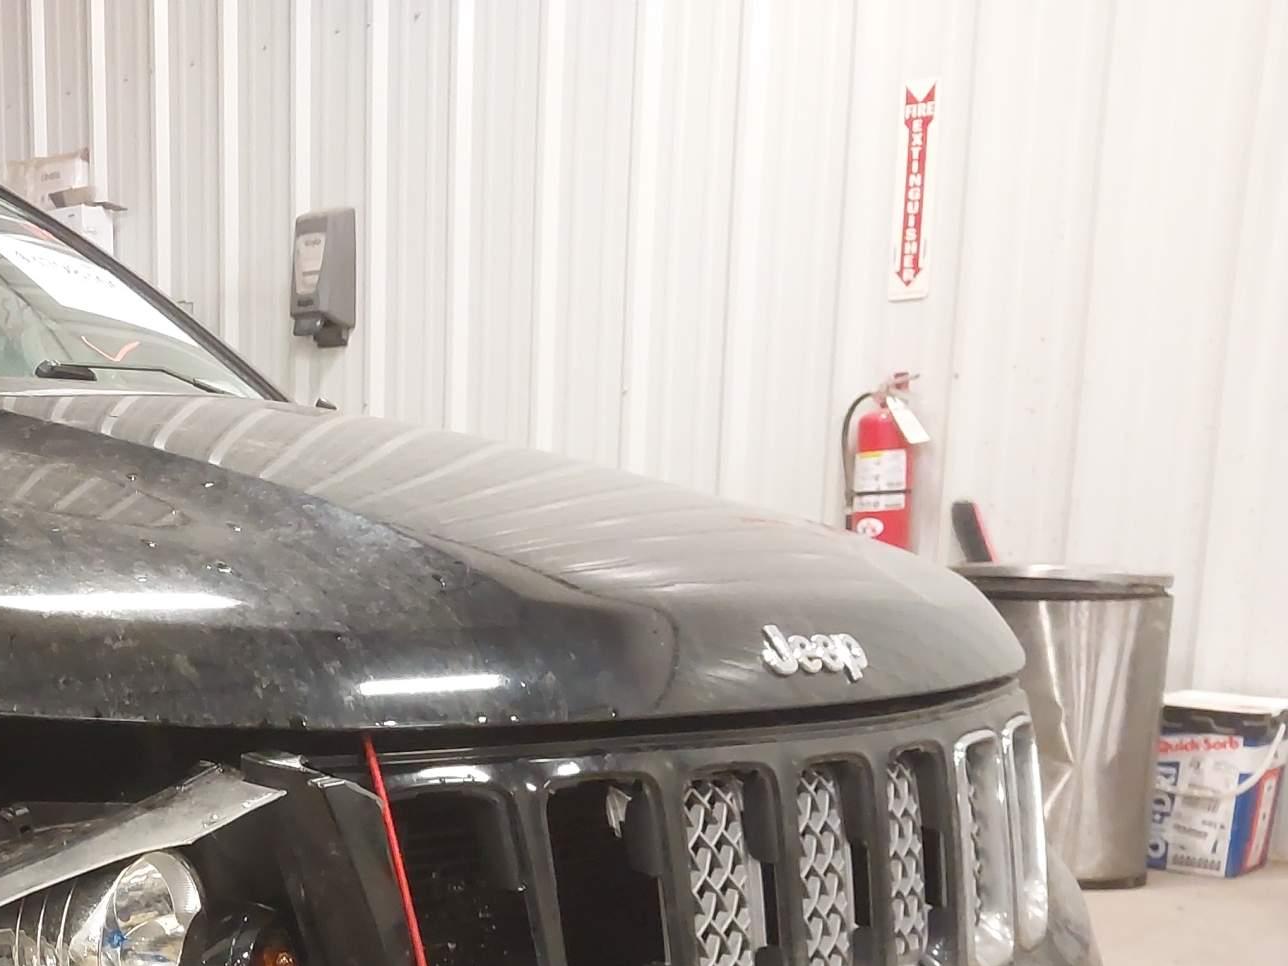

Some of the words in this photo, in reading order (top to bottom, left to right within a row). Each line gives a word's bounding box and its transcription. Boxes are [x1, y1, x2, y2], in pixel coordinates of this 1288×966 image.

[904, 101, 935, 119] FIRE
[902, 119, 923, 281] EXTINGUISHER
[761, 624, 868, 682] Jeep
